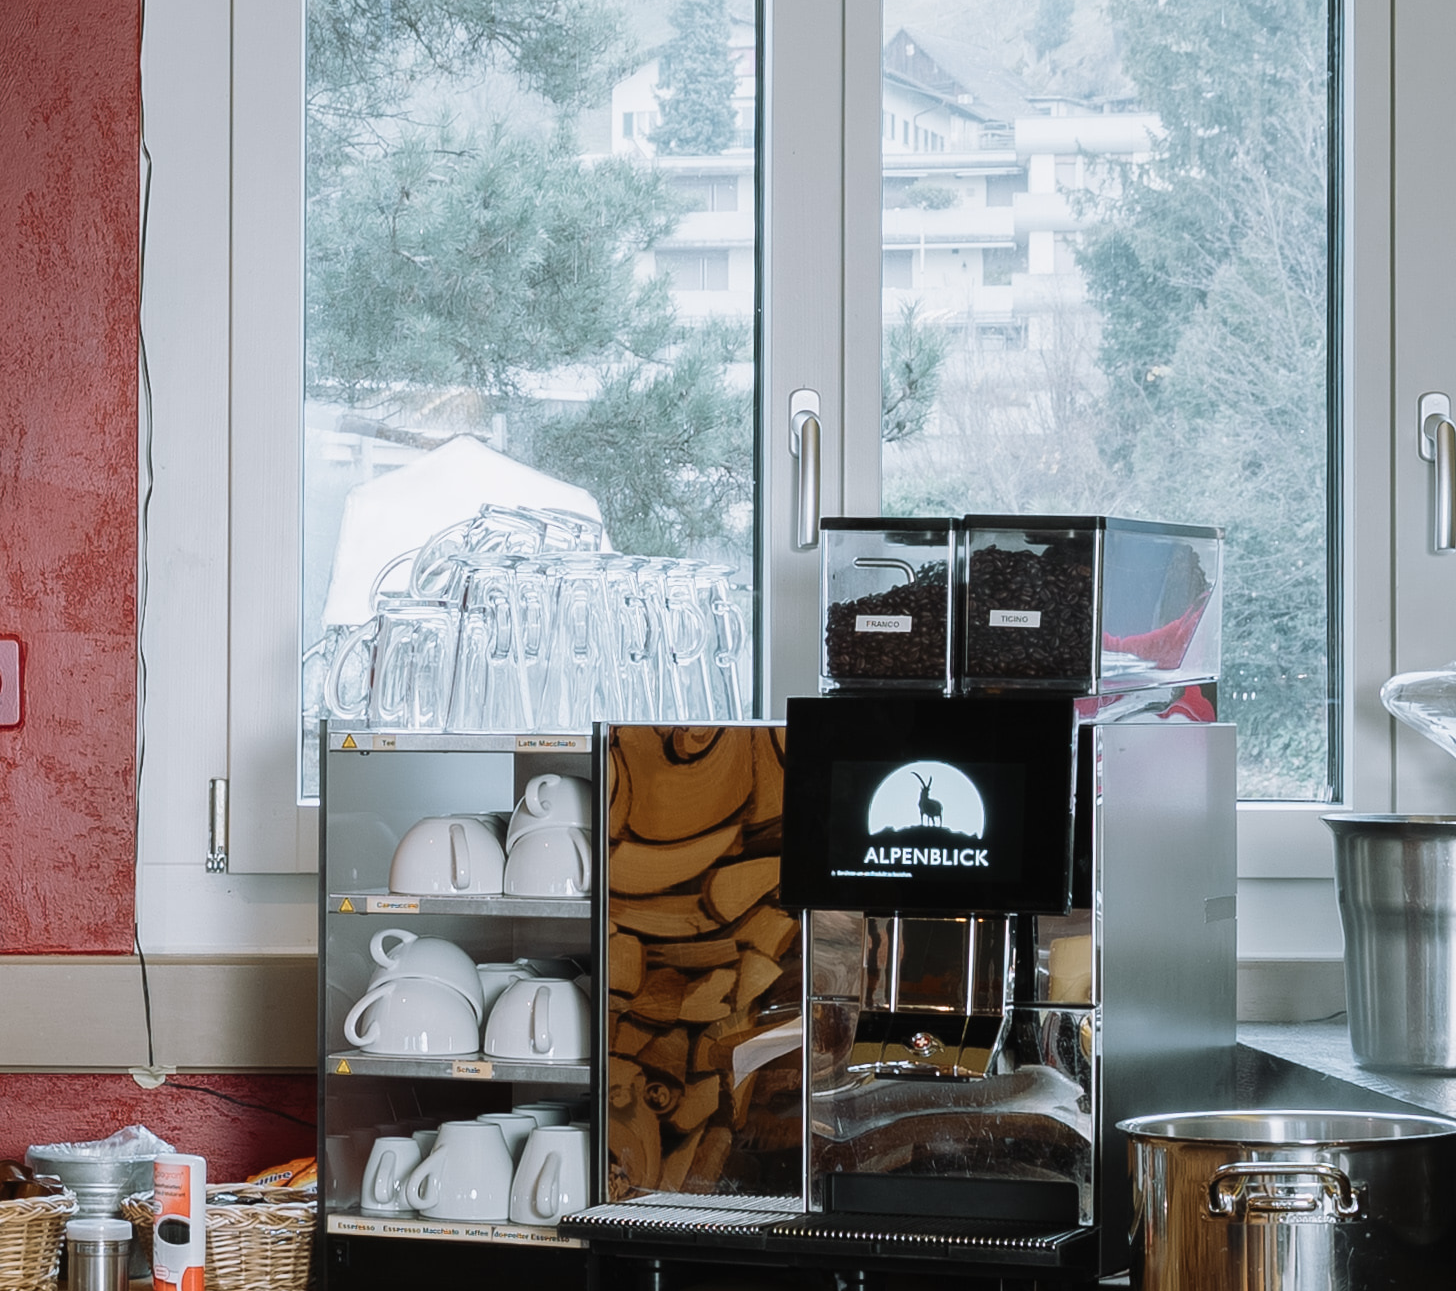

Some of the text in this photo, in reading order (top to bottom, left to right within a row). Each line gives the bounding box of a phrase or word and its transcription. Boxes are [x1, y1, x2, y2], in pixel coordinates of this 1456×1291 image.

[1000, 615, 1029, 623] TICINO
[865, 620, 900, 628] FRANCO
[518, 739, 577, 749] Latte Macchiato
[863, 846, 990, 867] ALPENBLICK
[464, 1228, 489, 1237] Kaffee
